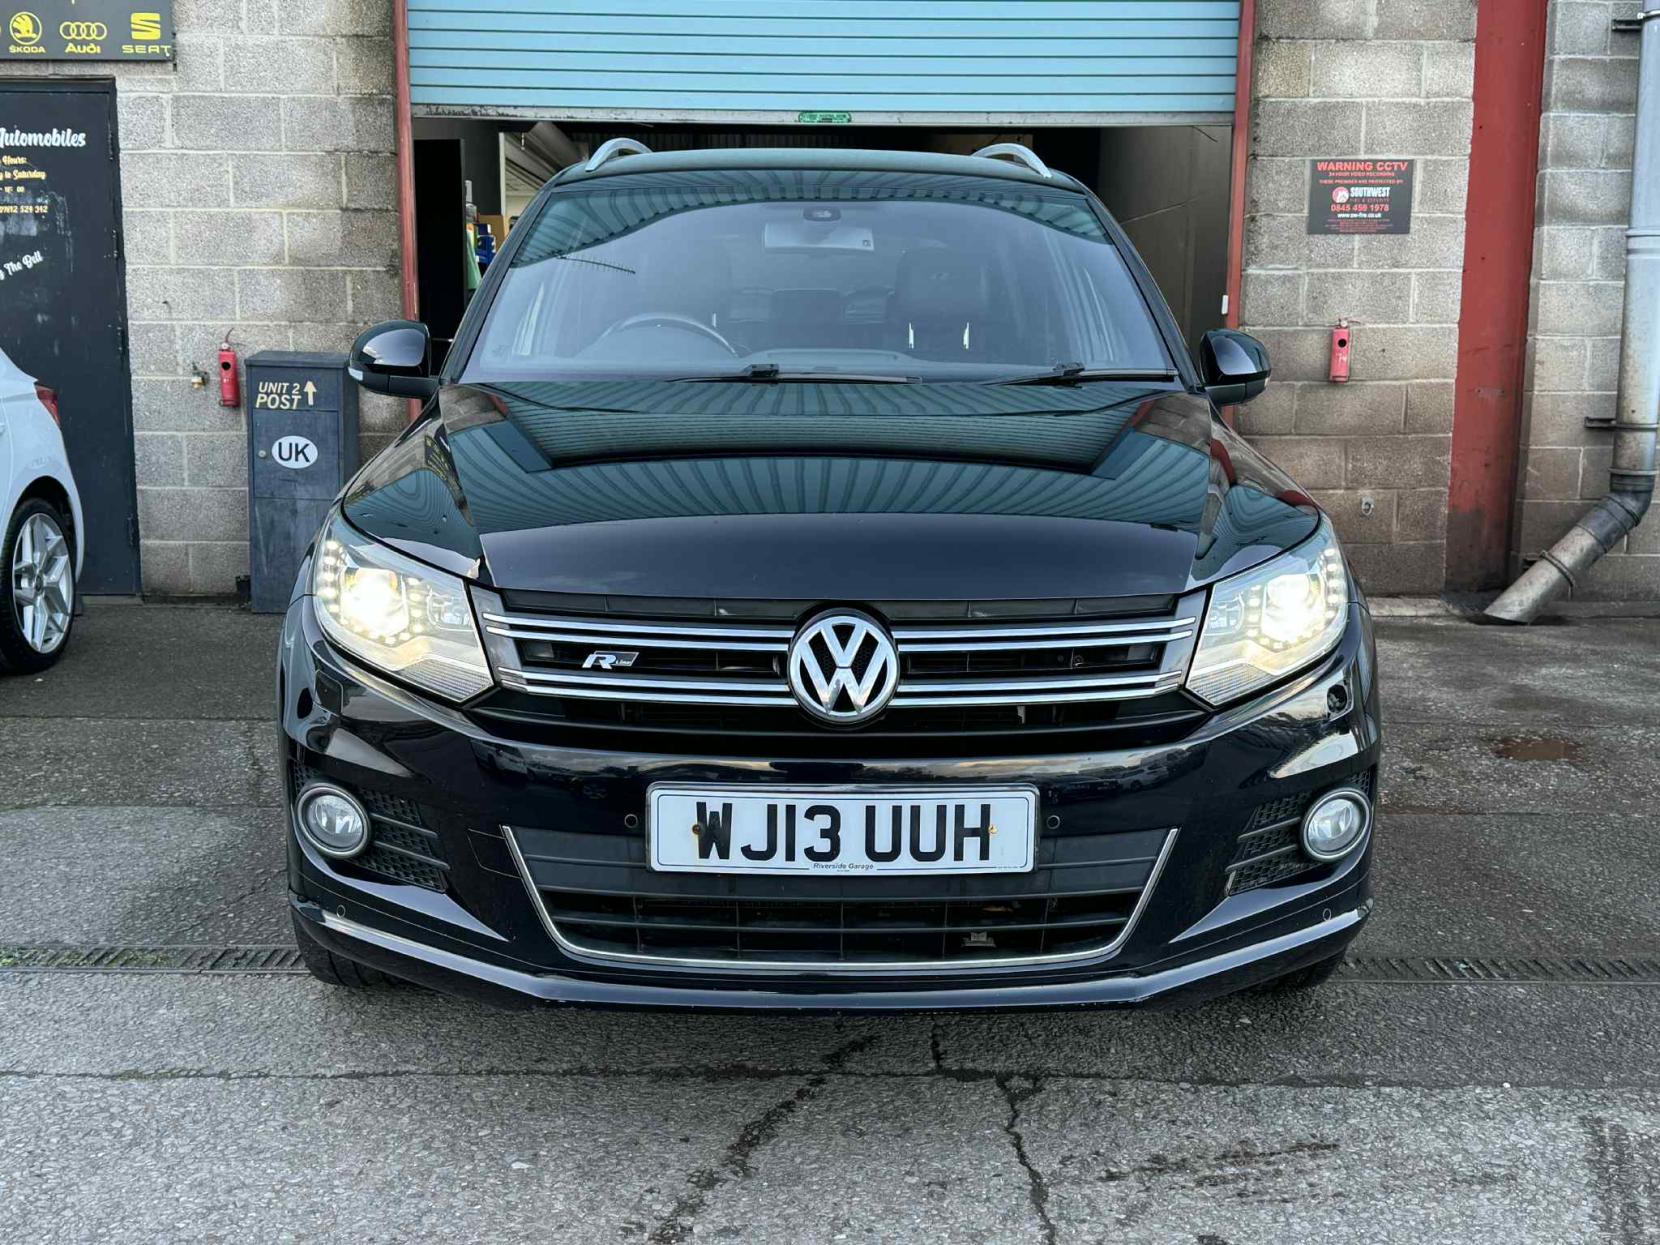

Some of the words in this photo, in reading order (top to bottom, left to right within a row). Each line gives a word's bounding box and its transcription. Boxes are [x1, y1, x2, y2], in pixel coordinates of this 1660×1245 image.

[65, 42, 101, 54] Audi
[122, 45, 171, 54] SEAT
[1317, 161, 1373, 171] WARNING
[1376, 161, 1409, 171] CCTV
[12, 170, 47, 180] Saturday
[1350, 186, 1391, 197] SOUTHWEST
[4, 261, 22, 276] The
[258, 382, 290, 394] UNIT
[292, 383, 301, 394] 2
[256, 394, 302, 410] POST
[278, 442, 310, 462] UK
[696, 802, 842, 863] WJ13
[865, 803, 991, 863] UUH
[848, 863, 874, 871] Garage
